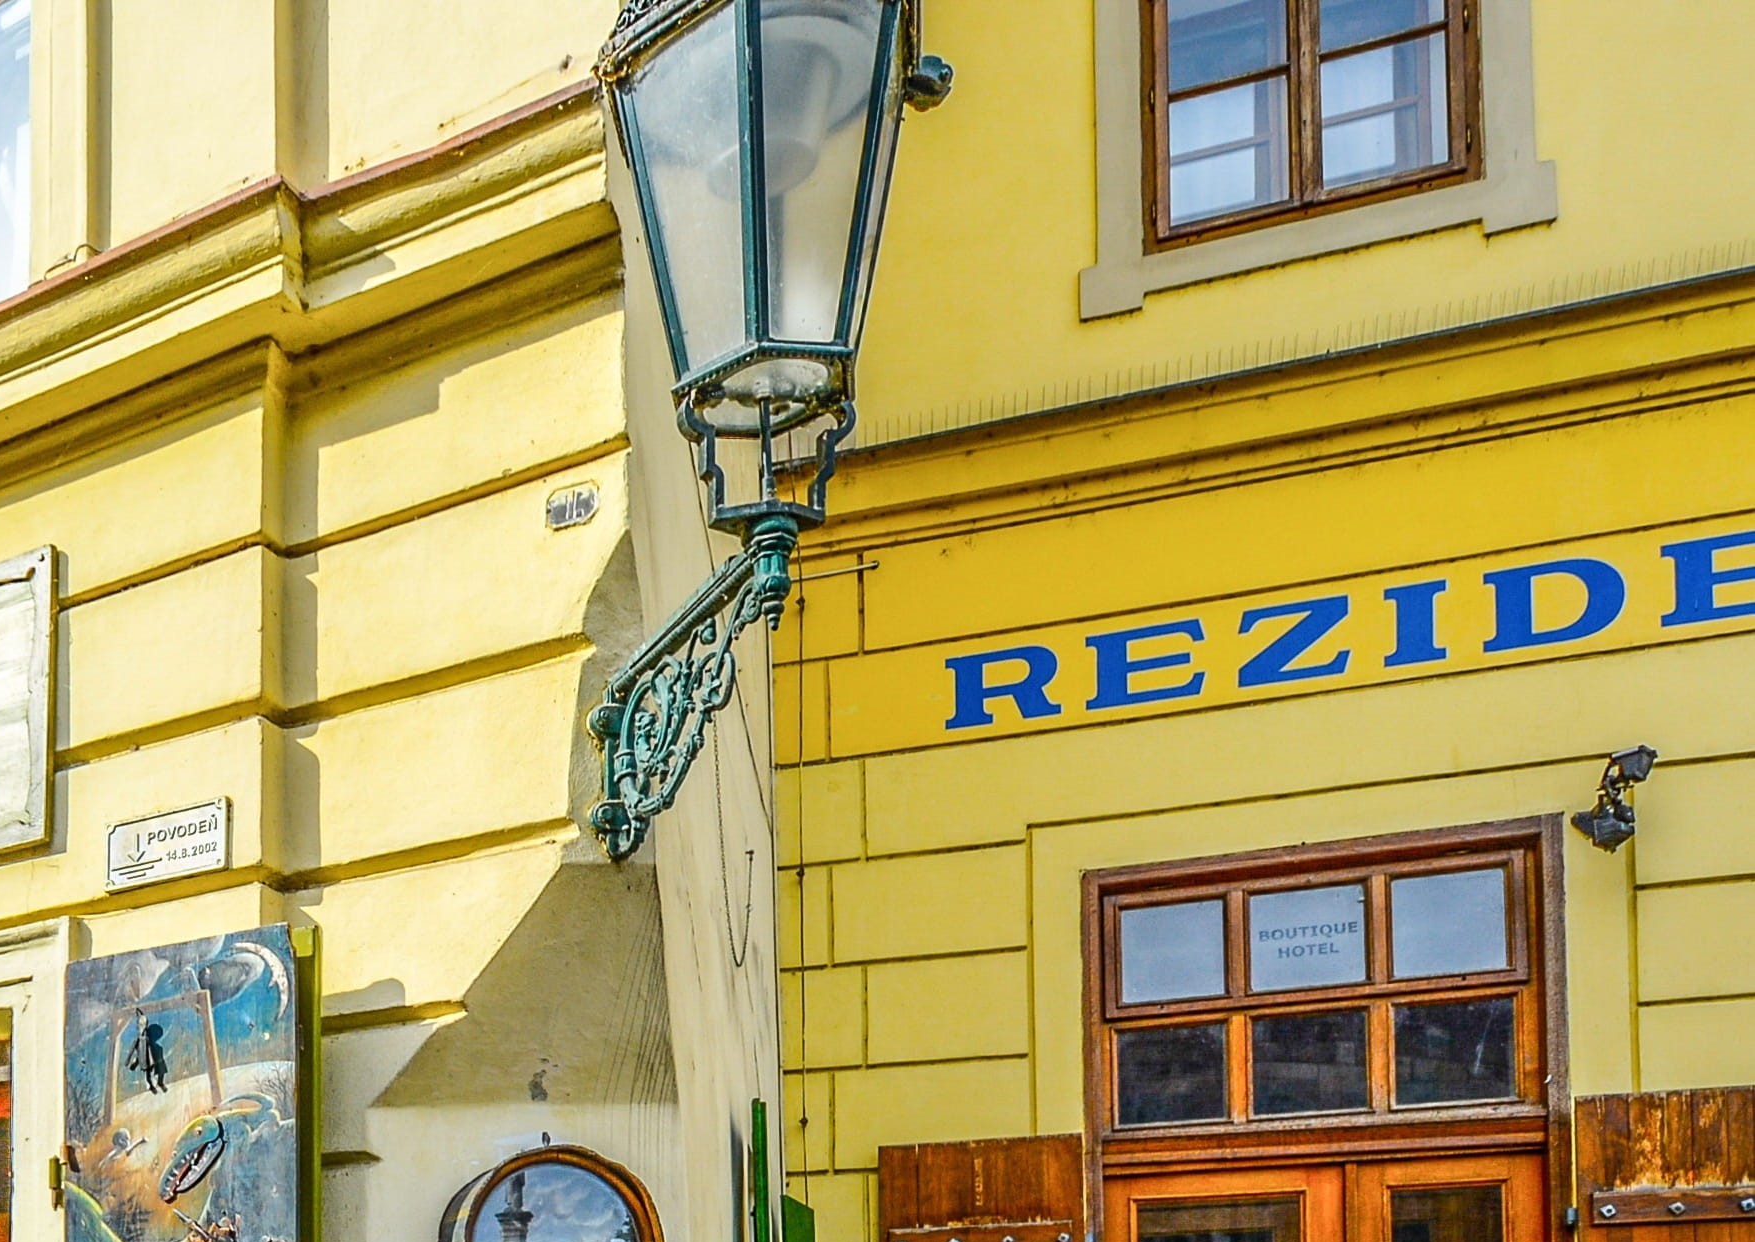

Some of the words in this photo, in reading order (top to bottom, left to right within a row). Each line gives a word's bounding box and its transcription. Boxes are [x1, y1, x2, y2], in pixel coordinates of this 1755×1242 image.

[943, 530, 1755, 731] REZIDE
[147, 812, 218, 846] POVODEŇ
[165, 841, 218, 861] 14.8.2002
[1259, 921, 1358, 942] BOUTIQUE
[1278, 942, 1340, 959] HOTEL
